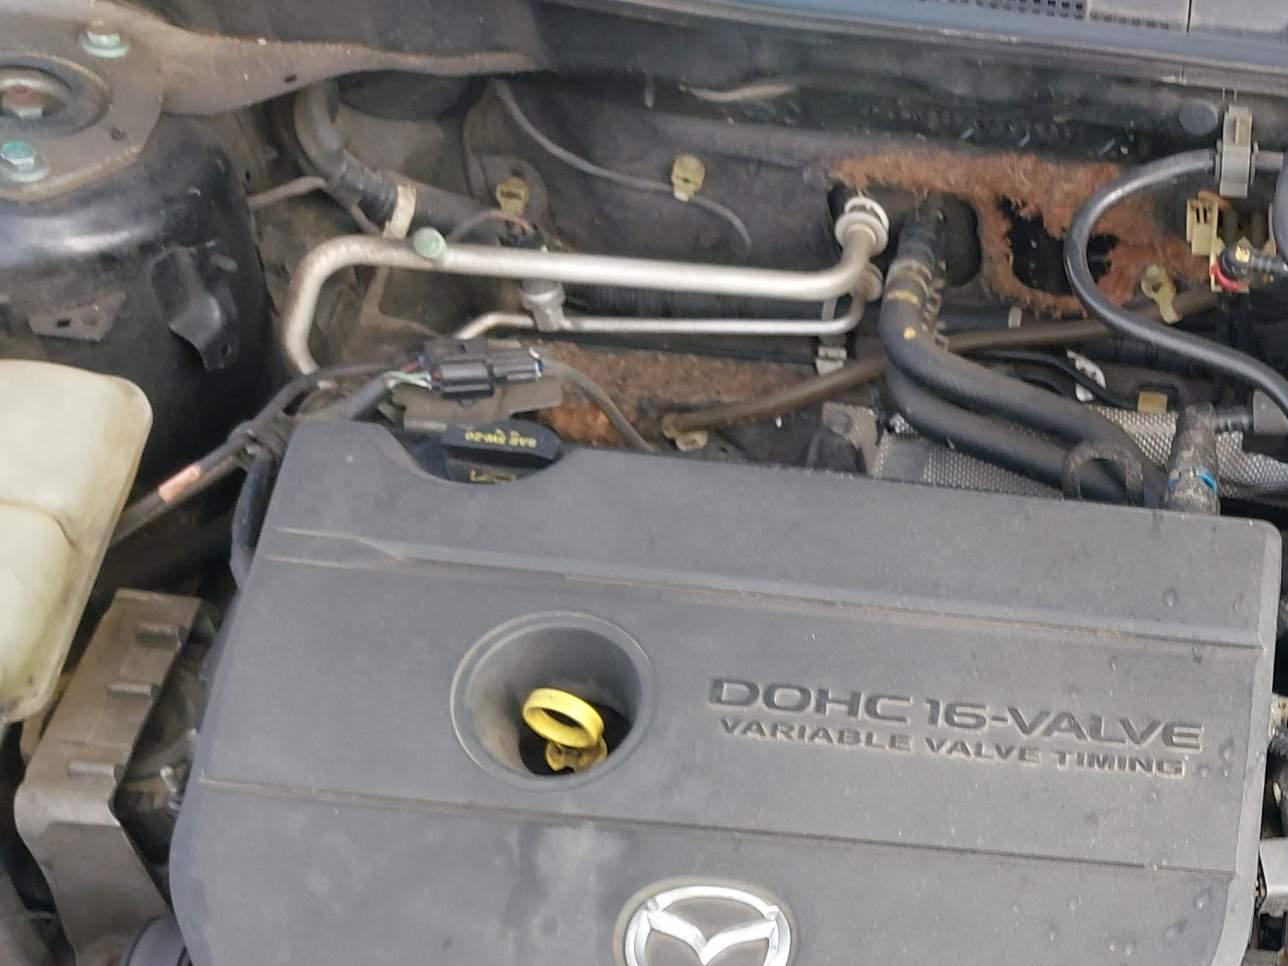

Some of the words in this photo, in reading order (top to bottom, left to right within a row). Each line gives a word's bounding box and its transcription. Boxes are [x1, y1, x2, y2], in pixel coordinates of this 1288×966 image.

[707, 678, 912, 726] DOHC
[925, 699, 1203, 751] 16-VALVE
[719, 717, 912, 752] VARIABLE
[925, 736, 1042, 766] VALVE
[1053, 751, 1187, 778] TIMING
